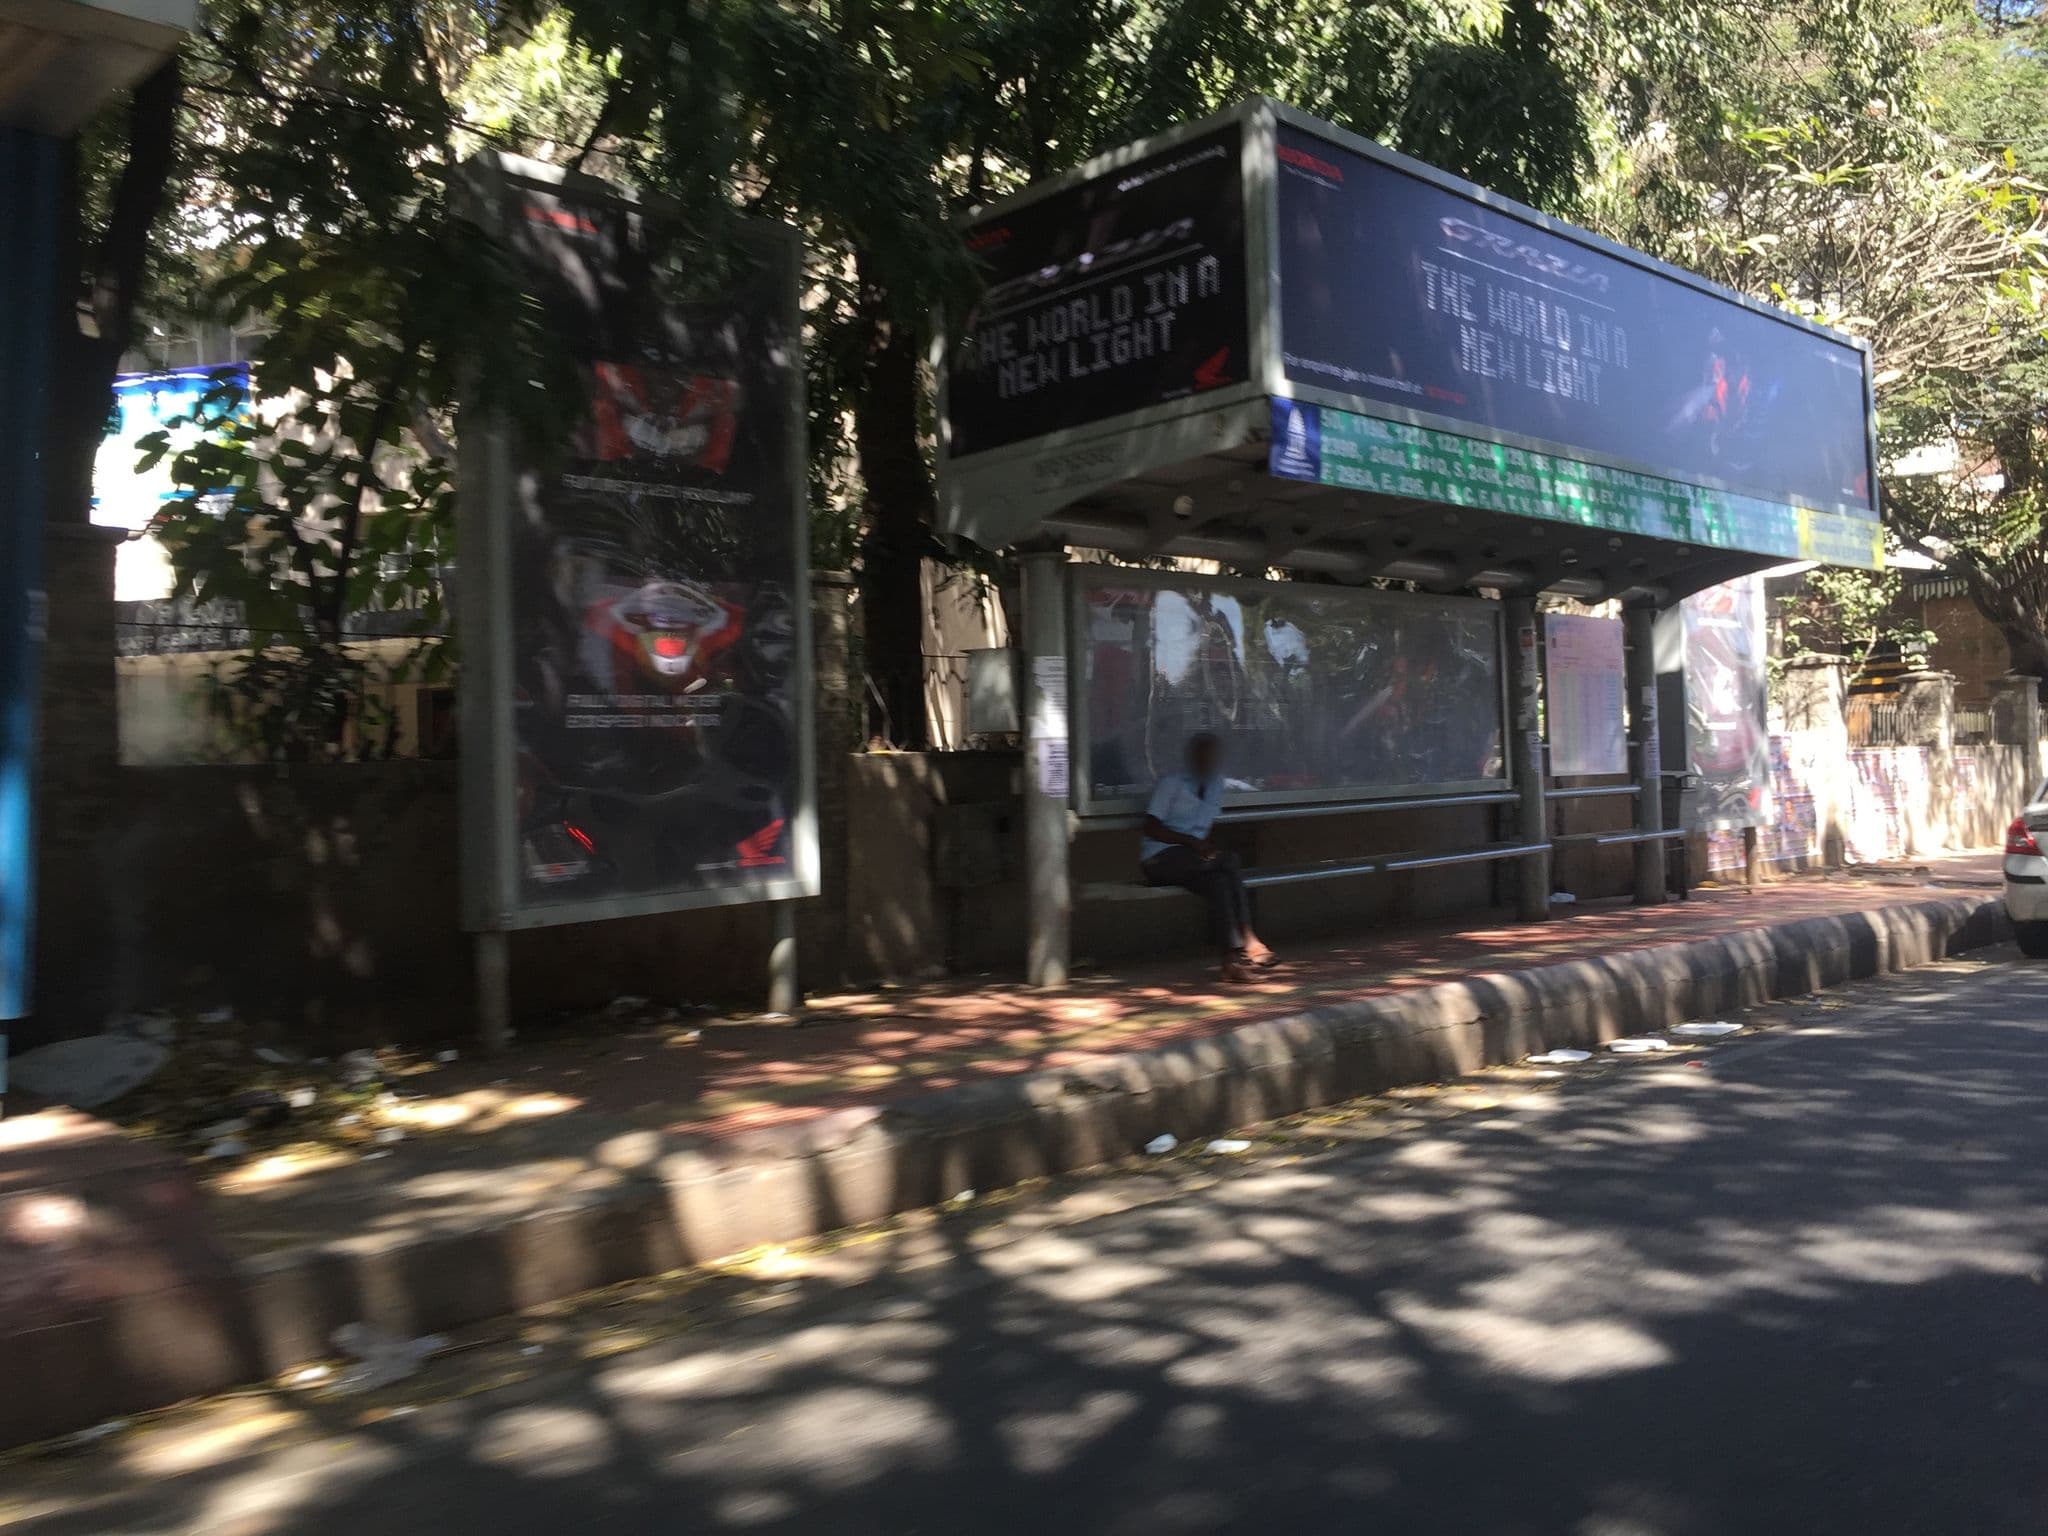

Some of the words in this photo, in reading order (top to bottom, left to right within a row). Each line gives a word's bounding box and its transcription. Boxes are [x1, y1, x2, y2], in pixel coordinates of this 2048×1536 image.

[1027, 284, 1134, 350] WORLD
[1143, 264, 1190, 314] IN
[1196, 253, 1222, 299] A
[1420, 260, 1477, 323] THE
[1487, 282, 1571, 352] WORLD
[1578, 313, 1610, 364] IN
[1614, 326, 1629, 369] A
[997, 346, 1062, 400] NEW
[1068, 311, 1177, 379] LIGHT
[1460, 324, 1517, 383] NEW
[1525, 343, 1601, 408] LIGHT
